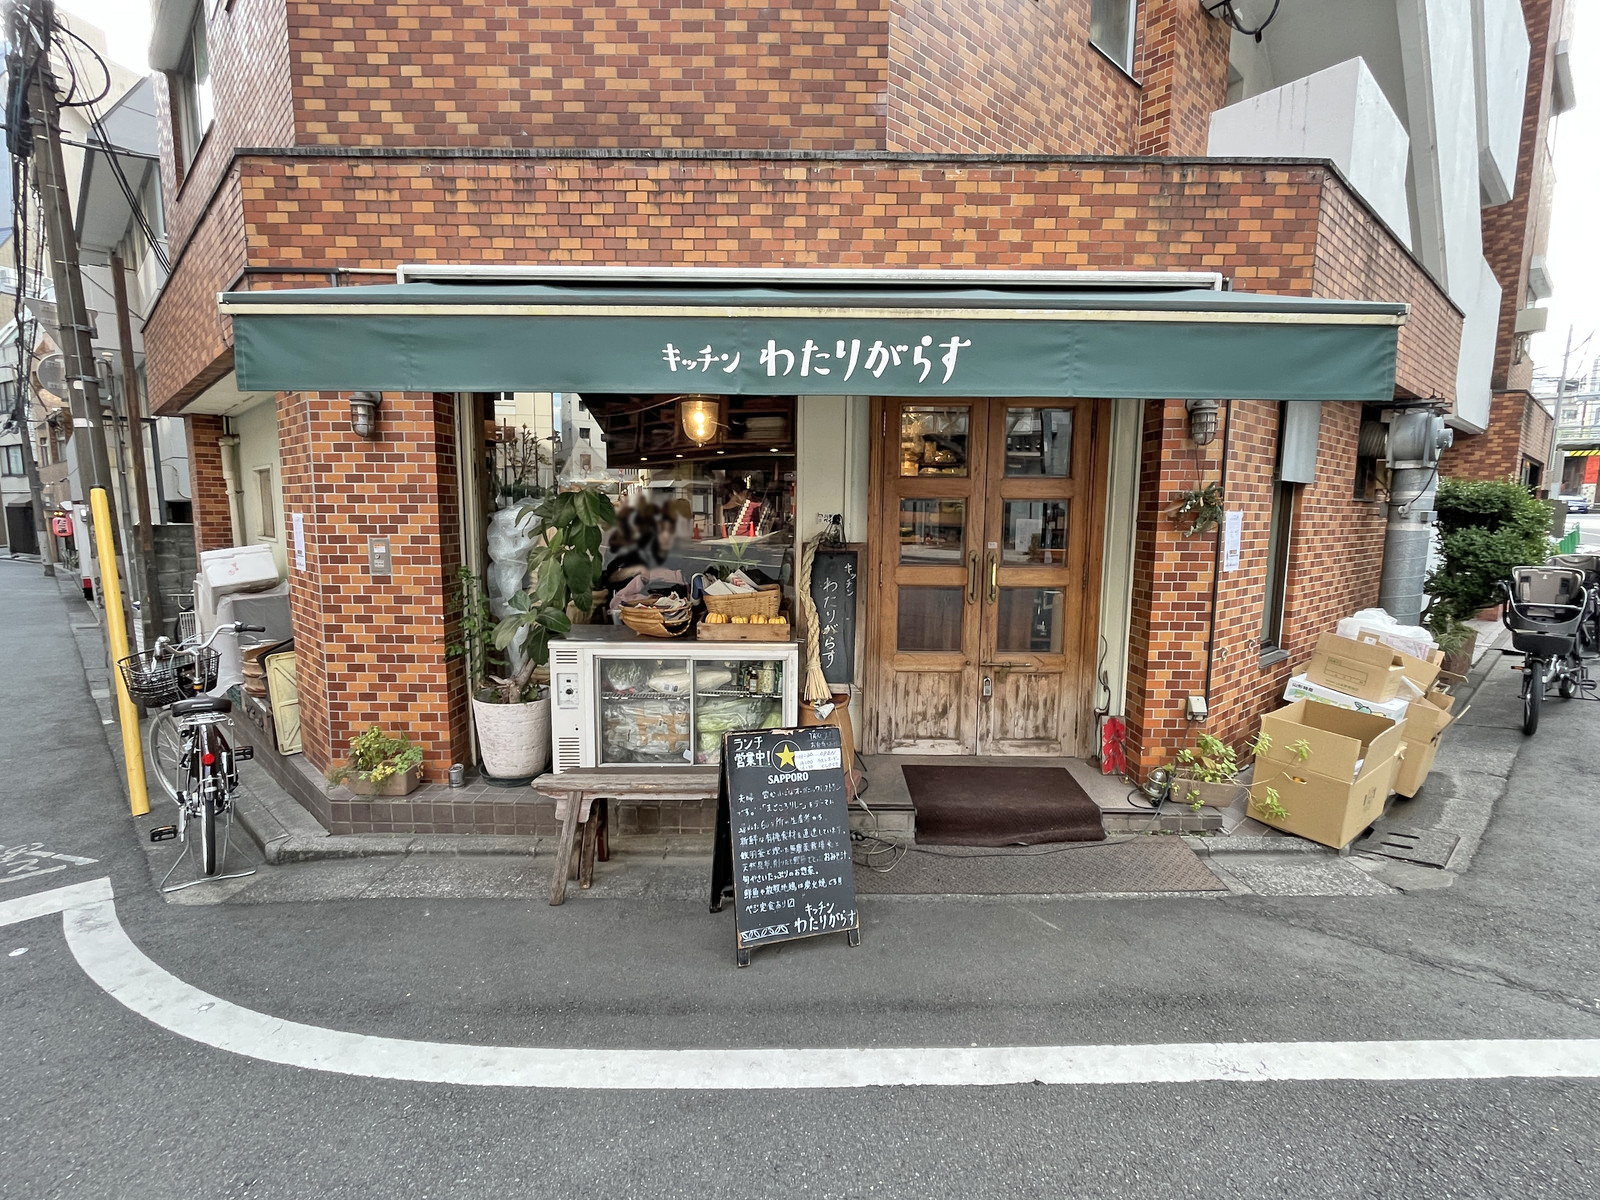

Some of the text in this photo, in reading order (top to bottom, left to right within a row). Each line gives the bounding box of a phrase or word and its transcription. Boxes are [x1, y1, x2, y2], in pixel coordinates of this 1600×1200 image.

[662, 335, 972, 384] キッチン わたりがらす
[844, 562, 856, 597] キッチン
[822, 577, 838, 669] わたりがらす
[733, 736, 763, 752] ランチ
[767, 771, 809, 785] SAPPORO
[805, 901, 835, 917] キッチン
[794, 910, 857, 933] わたりがらす
